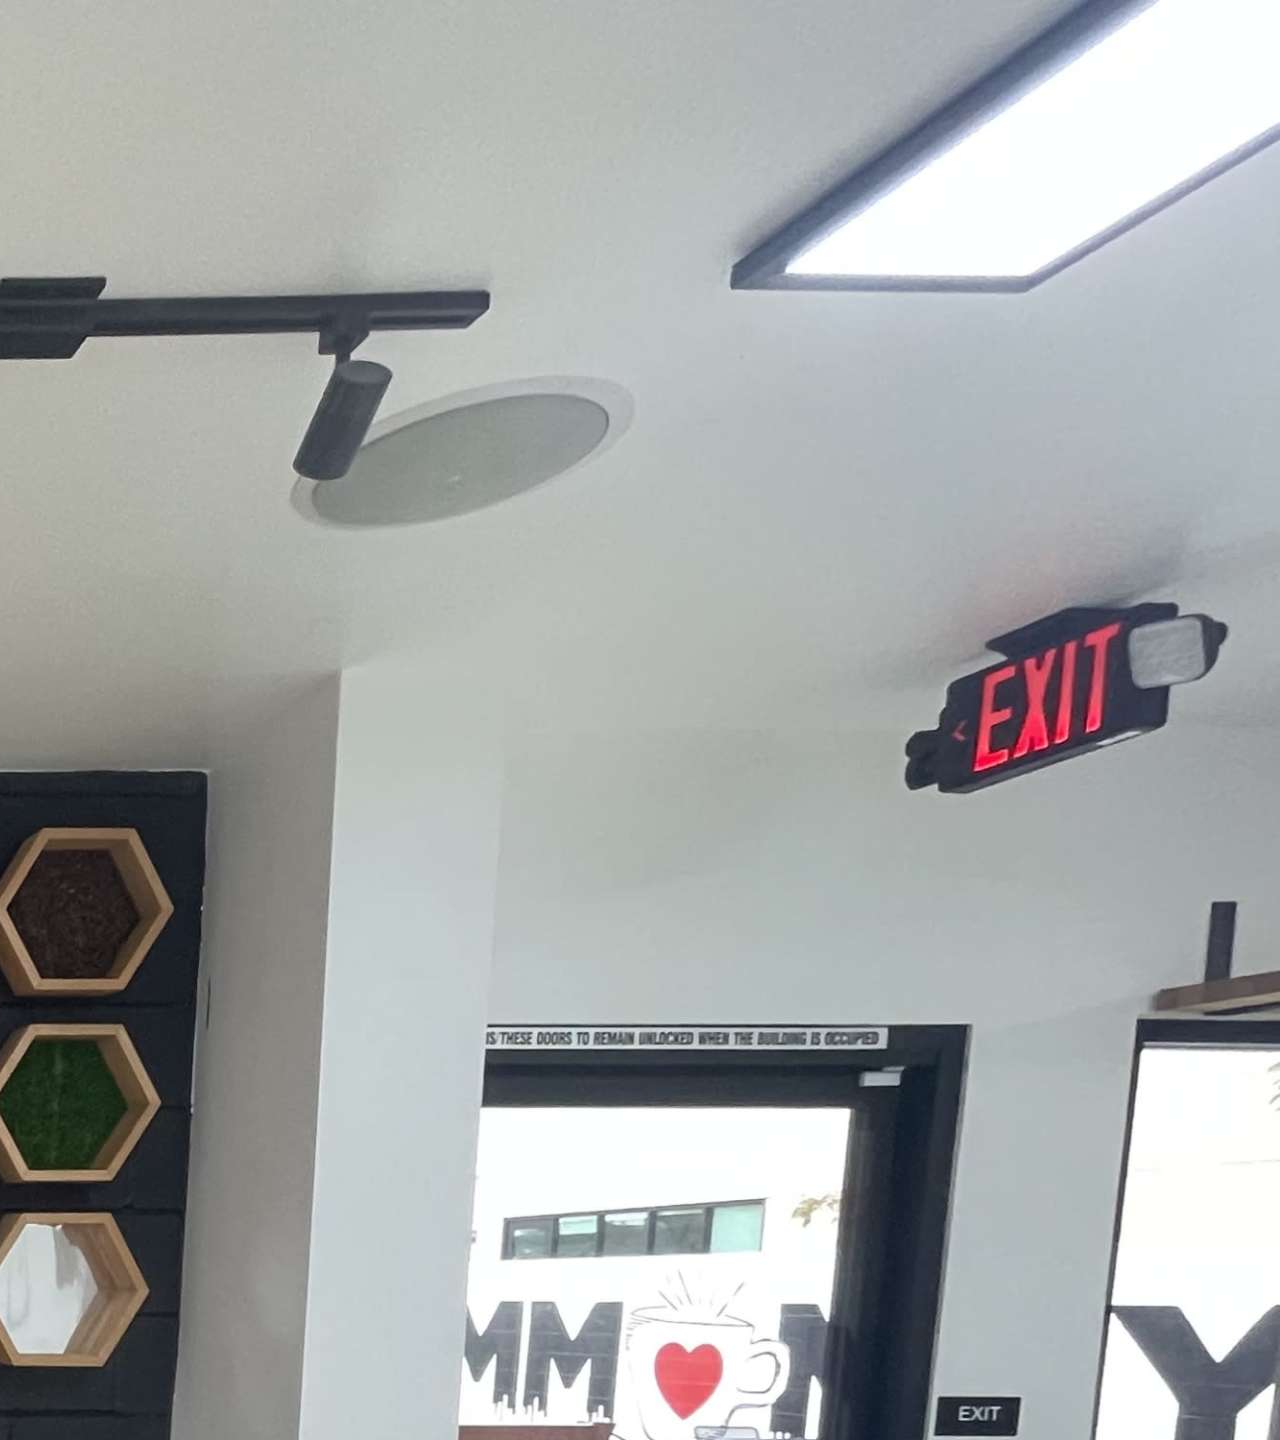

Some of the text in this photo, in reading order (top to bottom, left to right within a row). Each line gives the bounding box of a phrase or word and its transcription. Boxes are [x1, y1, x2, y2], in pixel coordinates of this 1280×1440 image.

[973, 622, 1121, 772] EXIT
[500, 1032, 533, 1045] THESE
[536, 1032, 572, 1045] DOORS
[576, 1032, 590, 1045] TO
[593, 1032, 635, 1045] REMAIN
[638, 1032, 693, 1045] UNLOCKED
[698, 1032, 730, 1045] WHEN
[734, 1032, 753, 1045] THE
[757, 1032, 807, 1045] BUILDING
[810, 1032, 821, 1045] IS
[824, 1032, 880, 1045] OCCUPIED
[957, 1405, 1002, 1422] EXIT
